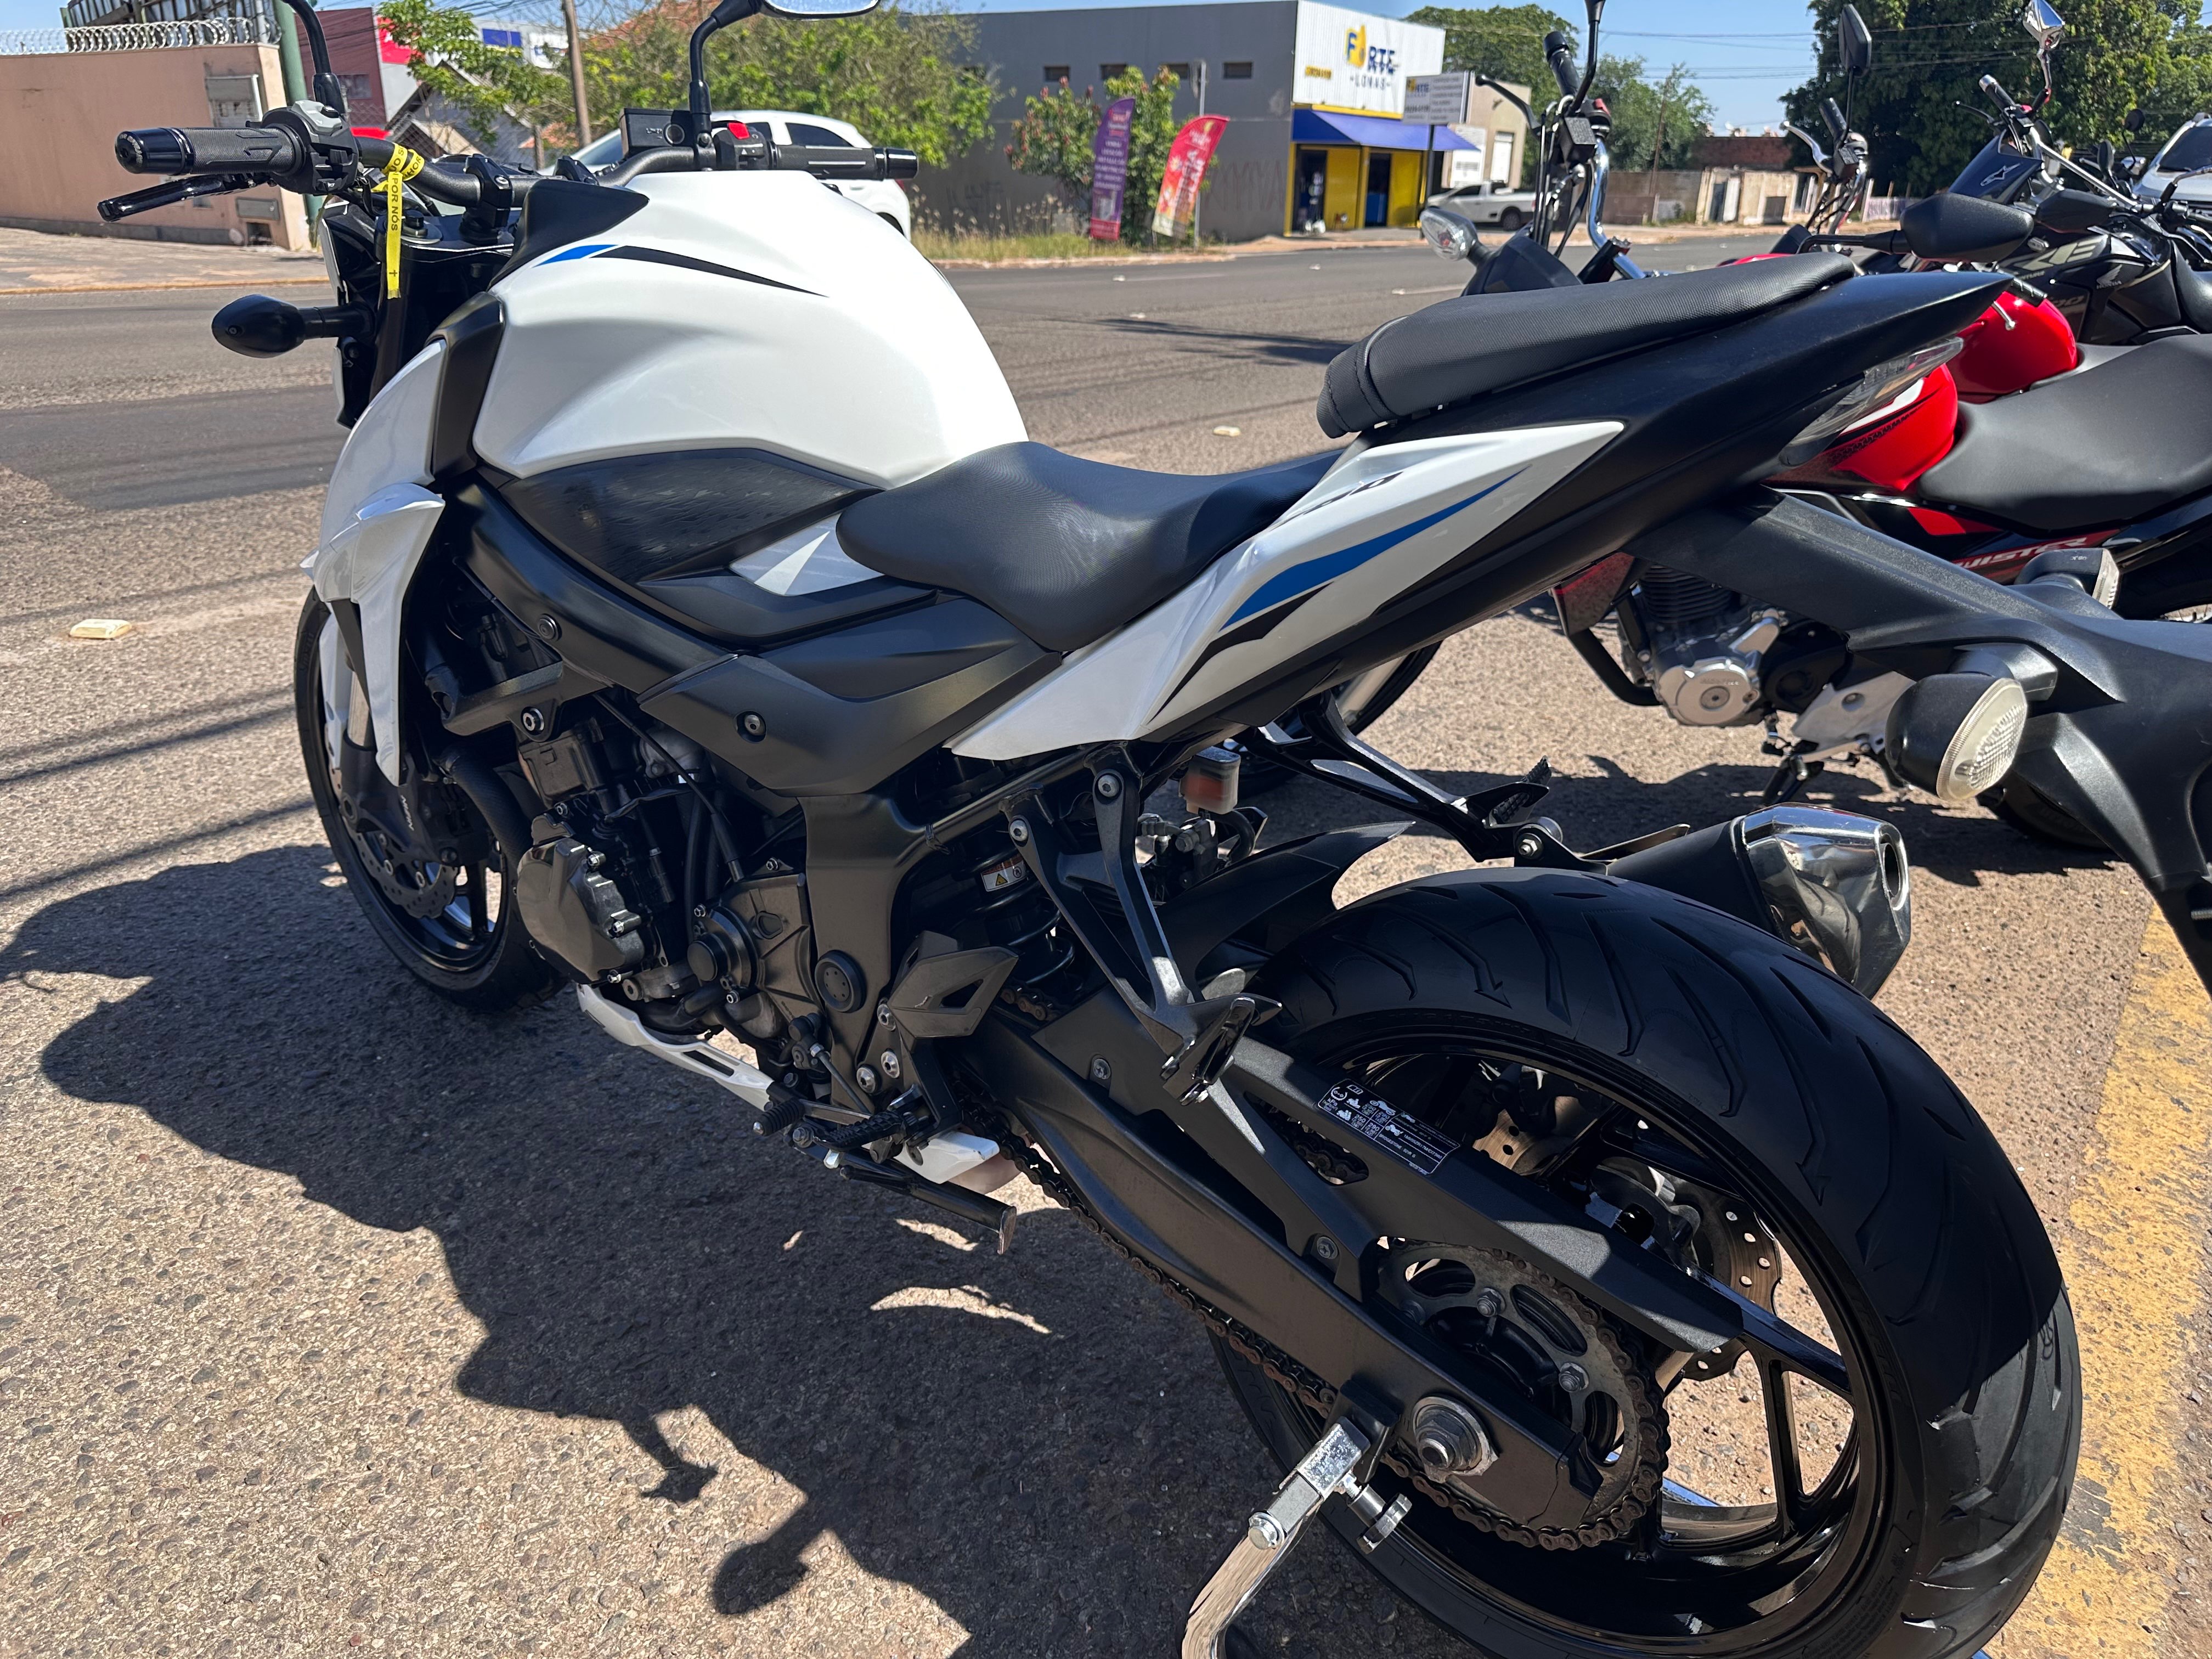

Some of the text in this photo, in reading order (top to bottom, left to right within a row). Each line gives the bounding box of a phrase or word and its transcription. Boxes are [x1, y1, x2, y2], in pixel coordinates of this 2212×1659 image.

[391, 206, 400, 231] NÓS
[1355, 1114, 1366, 1122] 250
[1368, 1122, 1380, 1131] 290
